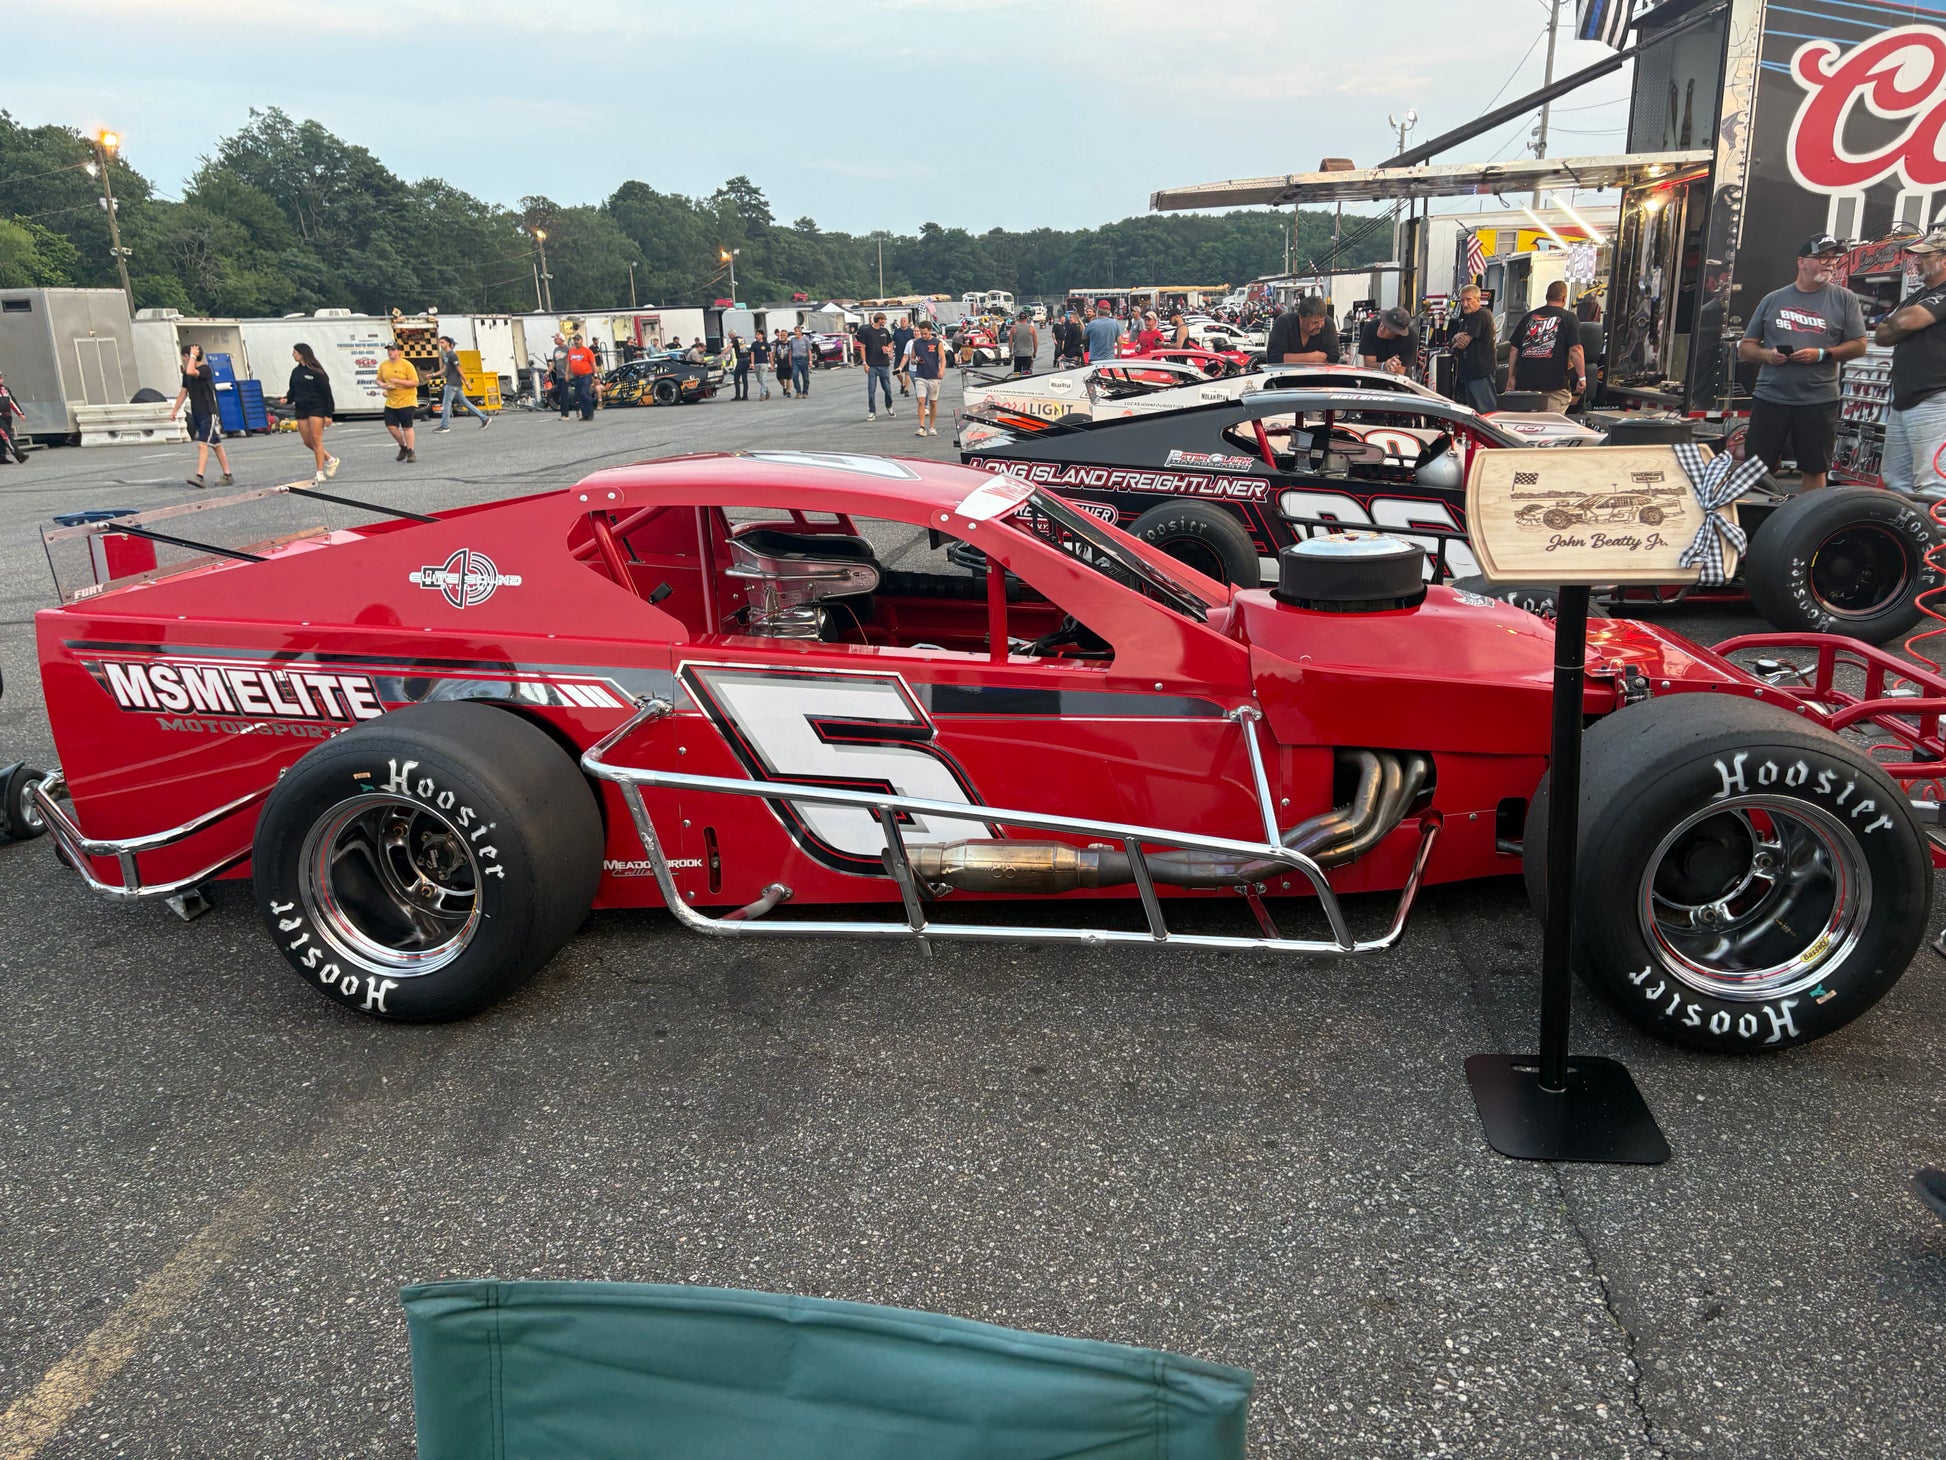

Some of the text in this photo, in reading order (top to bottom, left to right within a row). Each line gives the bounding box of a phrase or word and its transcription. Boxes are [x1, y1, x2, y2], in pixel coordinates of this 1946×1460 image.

[1776, 319, 1792, 331] 96
[1780, 310, 1828, 329] BRODE
[1028, 465, 1114, 488] ISLAND
[1110, 472, 1268, 501] FREIGHTLINER
[1546, 532, 1669, 552] John Beatty Jr.
[74, 583, 104, 599] FURY
[464, 574, 522, 587] SOUND
[101, 661, 385, 721] MSMELITE
[688, 668, 1000, 878] 5
[1711, 751, 1893, 834] Hoosier
[380, 758, 505, 880] Hoosier
[603, 859, 703, 871] MEADOBROOK
[269, 900, 399, 1013] Hoosier
[1628, 965, 1799, 1044] Hoosier
